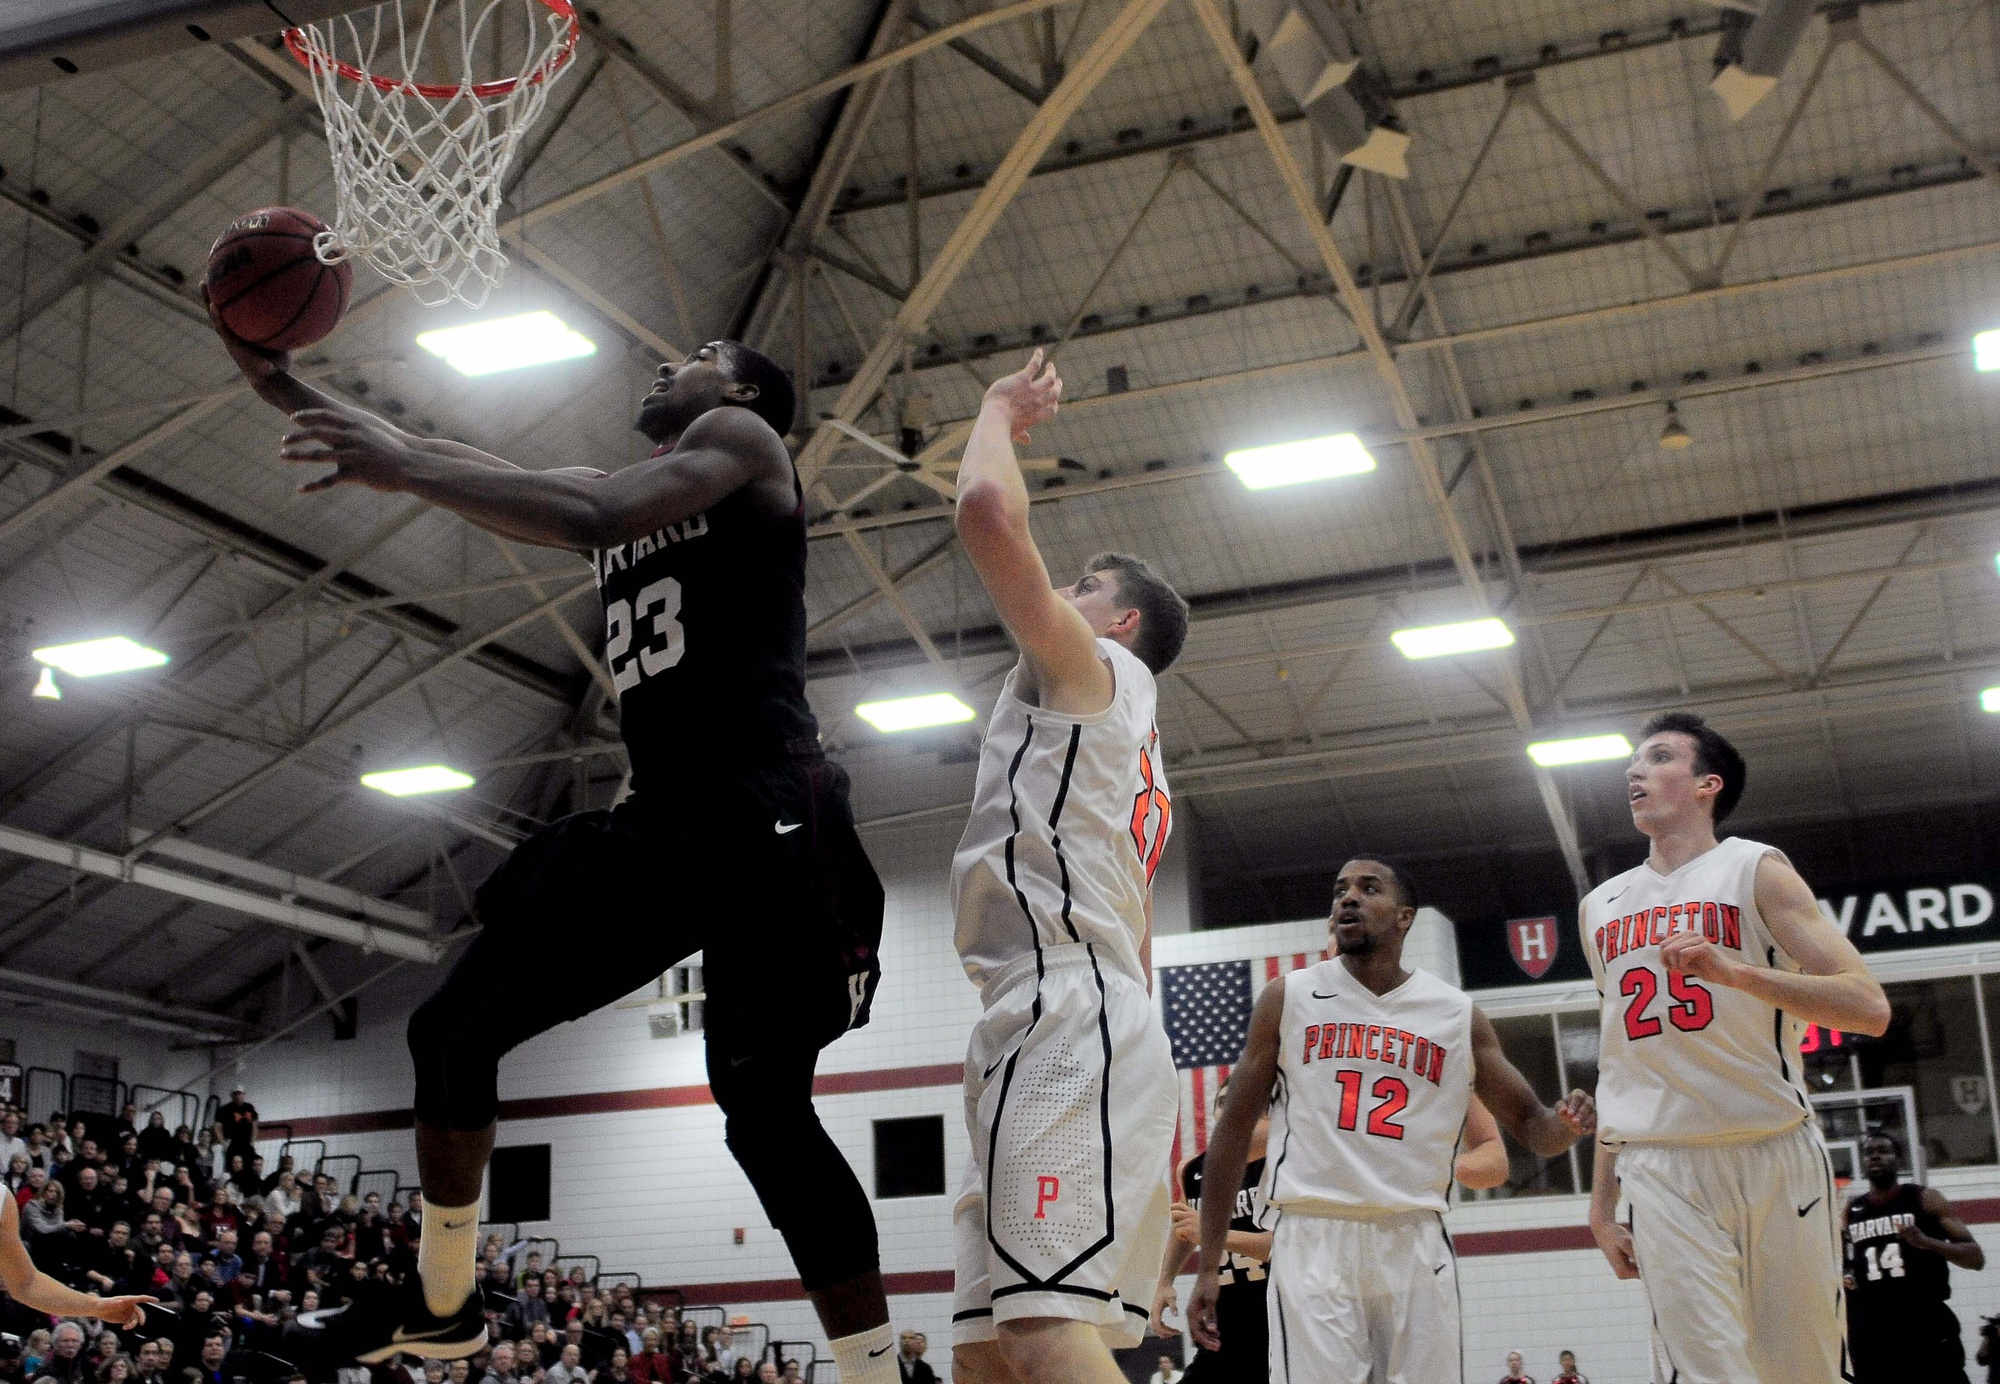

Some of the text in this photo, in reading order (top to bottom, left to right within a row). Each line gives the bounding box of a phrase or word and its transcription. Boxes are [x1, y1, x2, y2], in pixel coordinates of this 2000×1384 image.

[607, 576, 685, 700] 23
[1519, 923, 1547, 961] H
[1595, 901, 1741, 963] PRINCETON
[1620, 966, 1714, 1041] 25
[1302, 1022, 1446, 1087] PRINCETON
[1335, 1069, 1409, 1141] 12
[1034, 1175, 1060, 1219] P
[1864, 1242, 1906, 1281] 14
